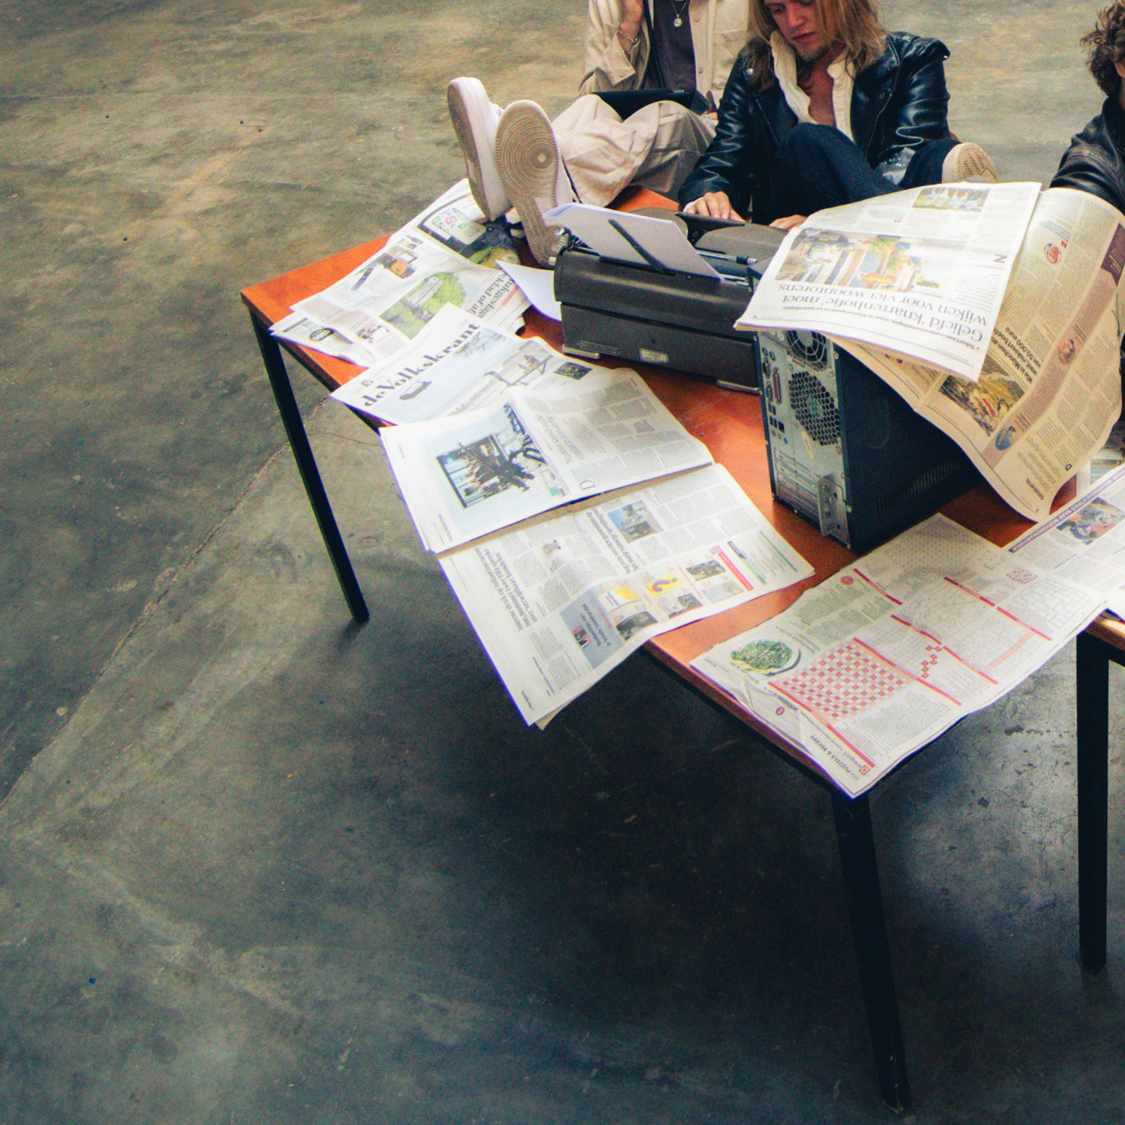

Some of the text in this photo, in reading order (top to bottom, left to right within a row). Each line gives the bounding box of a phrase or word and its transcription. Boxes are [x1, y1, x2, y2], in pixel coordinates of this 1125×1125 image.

[777, 284, 986, 325] wijken voor vier woontorens
[782, 295, 818, 304] moet
[928, 316, 983, 341] Geliefd
[509, 609, 524, 631] Interne
[830, 753, 851, 774] PUZZELS
